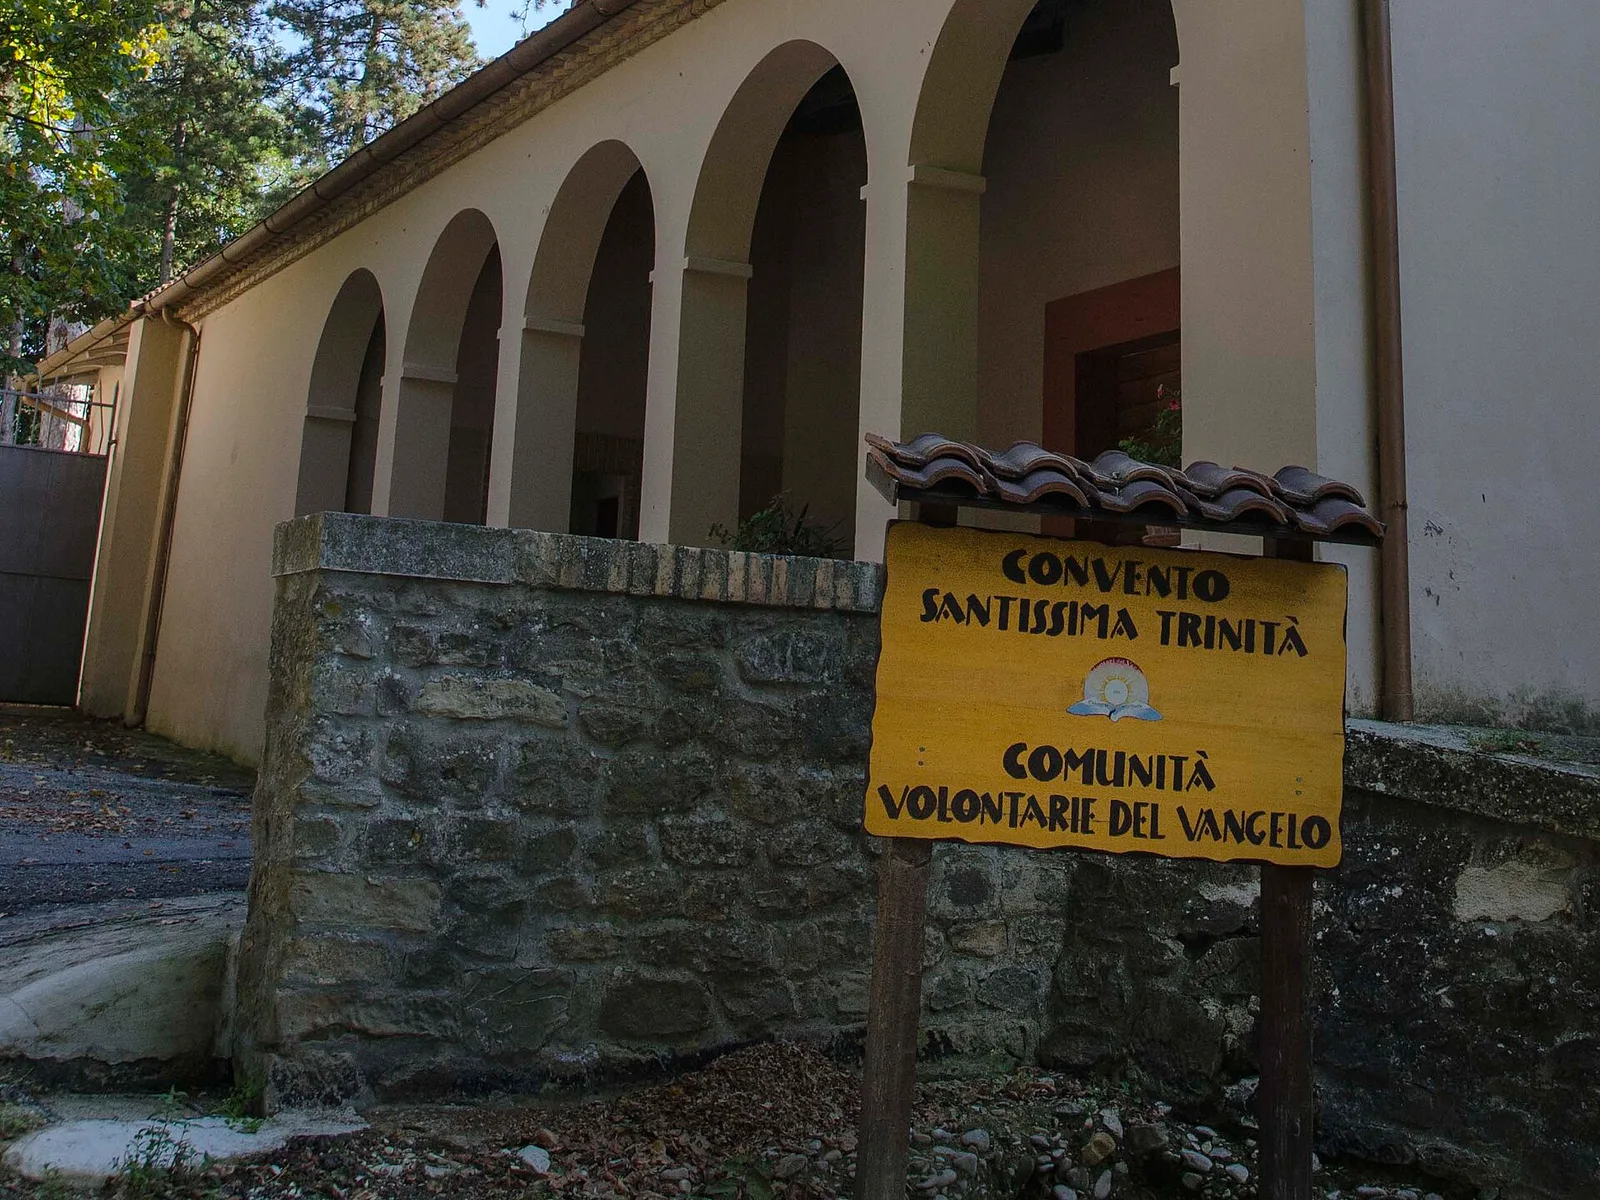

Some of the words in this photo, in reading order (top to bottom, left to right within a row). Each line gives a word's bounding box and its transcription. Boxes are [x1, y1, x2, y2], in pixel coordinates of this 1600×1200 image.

[1001, 549, 1231, 602] CONVENTO
[920, 588, 1139, 640] SANTISSIMA
[1156, 609, 1309, 657] TRINITÀ
[1002, 742, 1217, 793] COMUNITÀ
[877, 784, 1096, 835] VOLONTARIE
[1108, 801, 1166, 840] DEL
[1176, 805, 1332, 850] VANGELO
